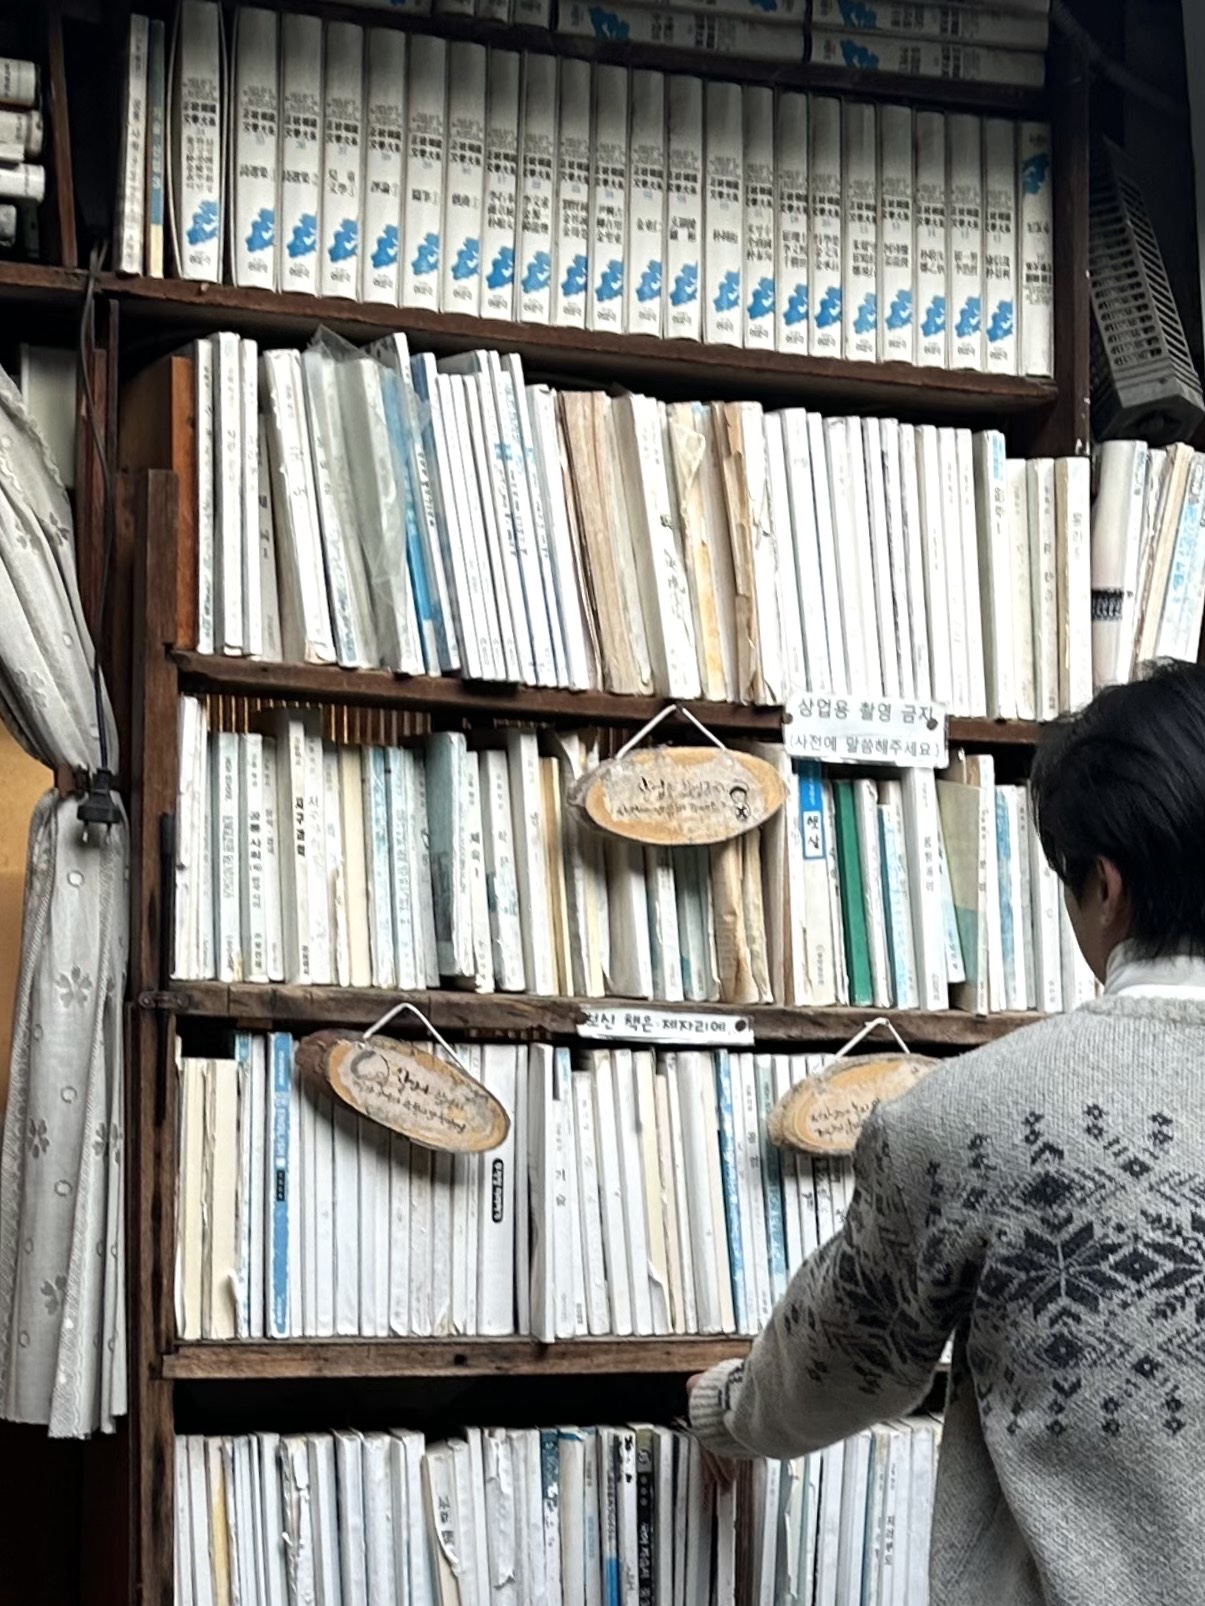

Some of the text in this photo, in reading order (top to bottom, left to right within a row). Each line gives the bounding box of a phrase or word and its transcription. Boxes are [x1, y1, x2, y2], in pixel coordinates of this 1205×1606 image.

[799, 698, 848, 719] 상업용
[860, 701, 891, 722] 촬영
[790, 734, 939, 757] (사전에 말씀해주세요)
[625, 1013, 653, 1033] 책은
